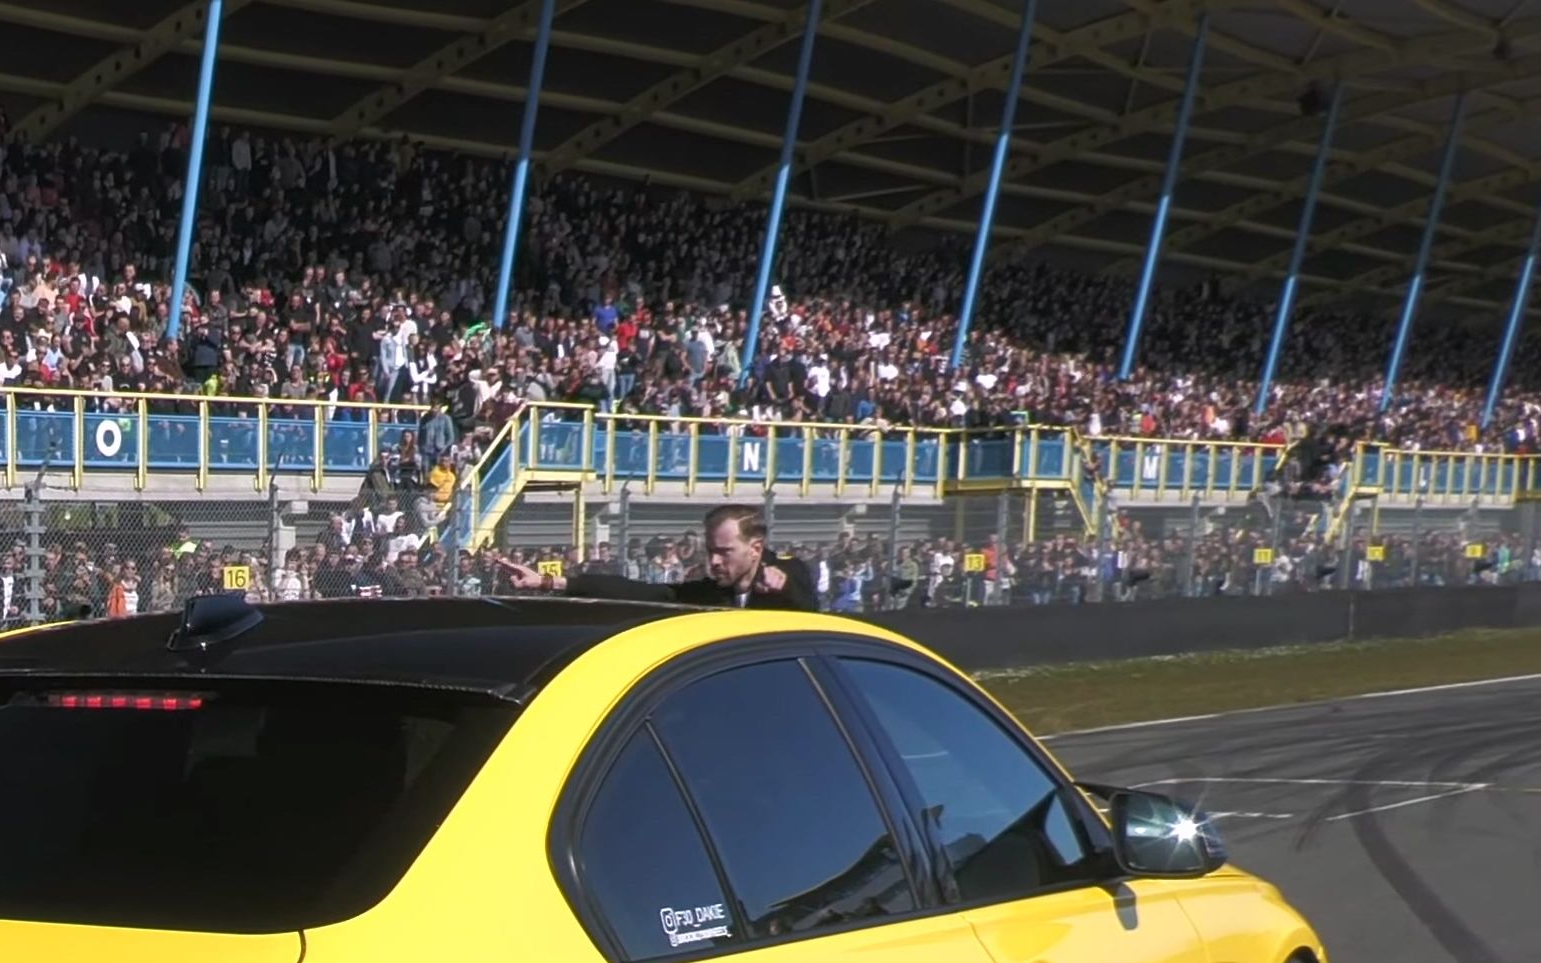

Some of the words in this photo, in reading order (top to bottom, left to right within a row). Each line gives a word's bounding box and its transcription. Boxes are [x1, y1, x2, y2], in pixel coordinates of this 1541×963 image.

[96, 419, 122, 457] O
[743, 442, 760, 471] N
[228, 569, 246, 588] 16
